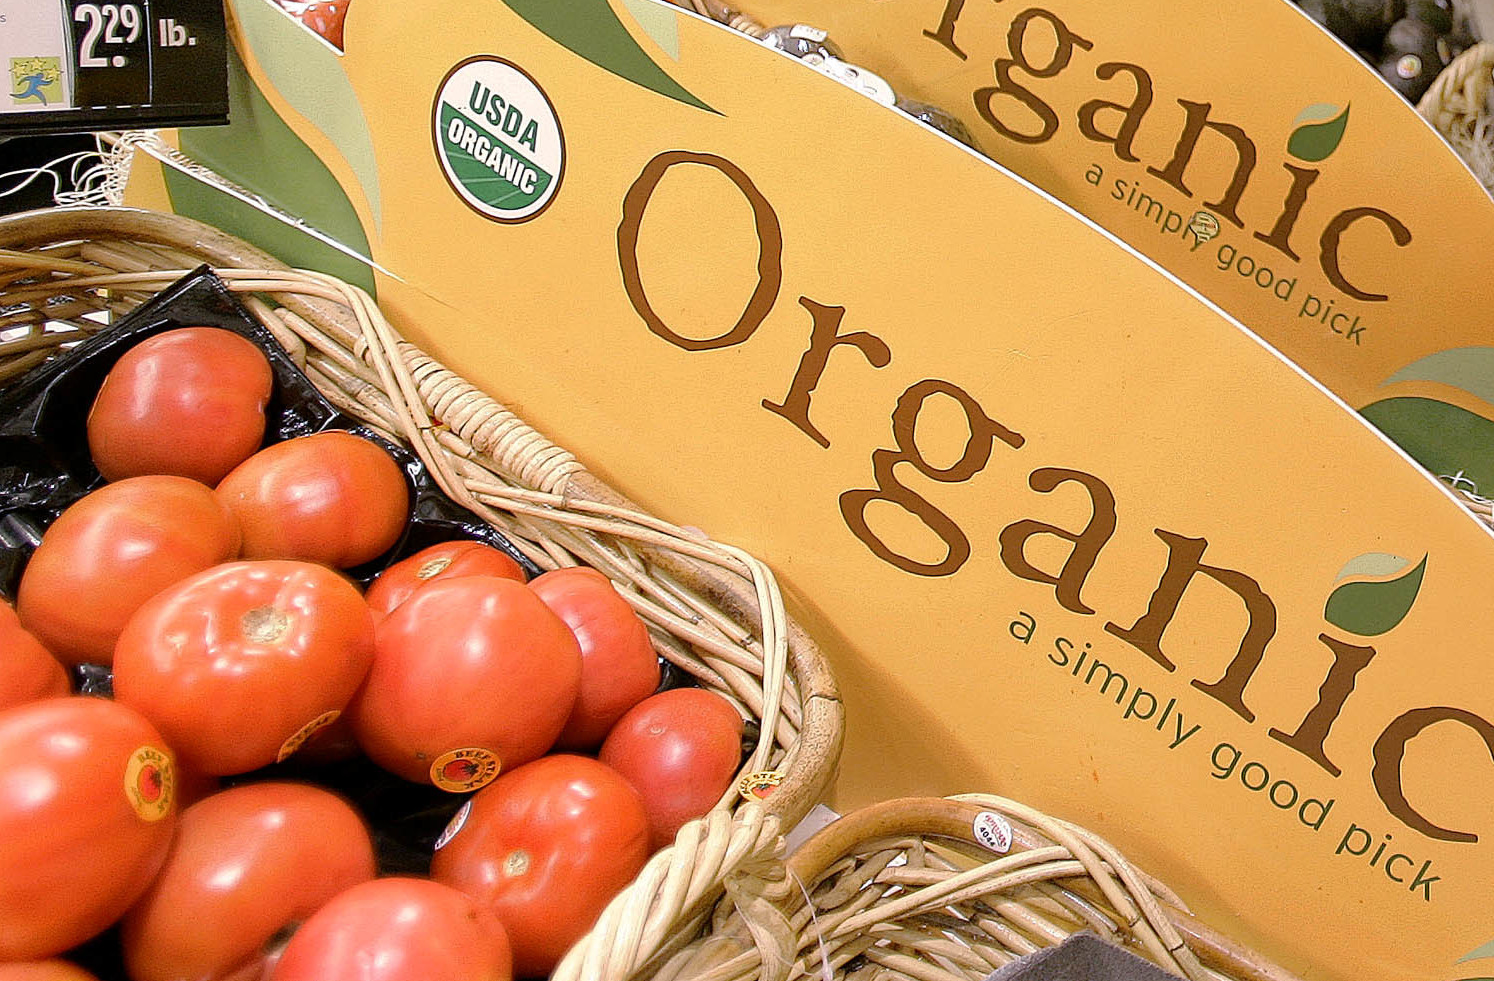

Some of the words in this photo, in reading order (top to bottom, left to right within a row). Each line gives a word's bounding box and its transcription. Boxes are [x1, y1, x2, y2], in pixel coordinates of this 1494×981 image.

[158, 18, 197, 48] lb.
[447, 117, 538, 196] ORGANIC
[469, 80, 539, 154] USDA
[1085, 162, 1103, 187] a
[1216, 243, 1298, 302] good
[1298, 293, 1367, 346] pick
[1008, 610, 1037, 645] a
[1047, 641, 1201, 750] simply
[1210, 742, 1335, 832] good
[1335, 822, 1442, 903] pick
